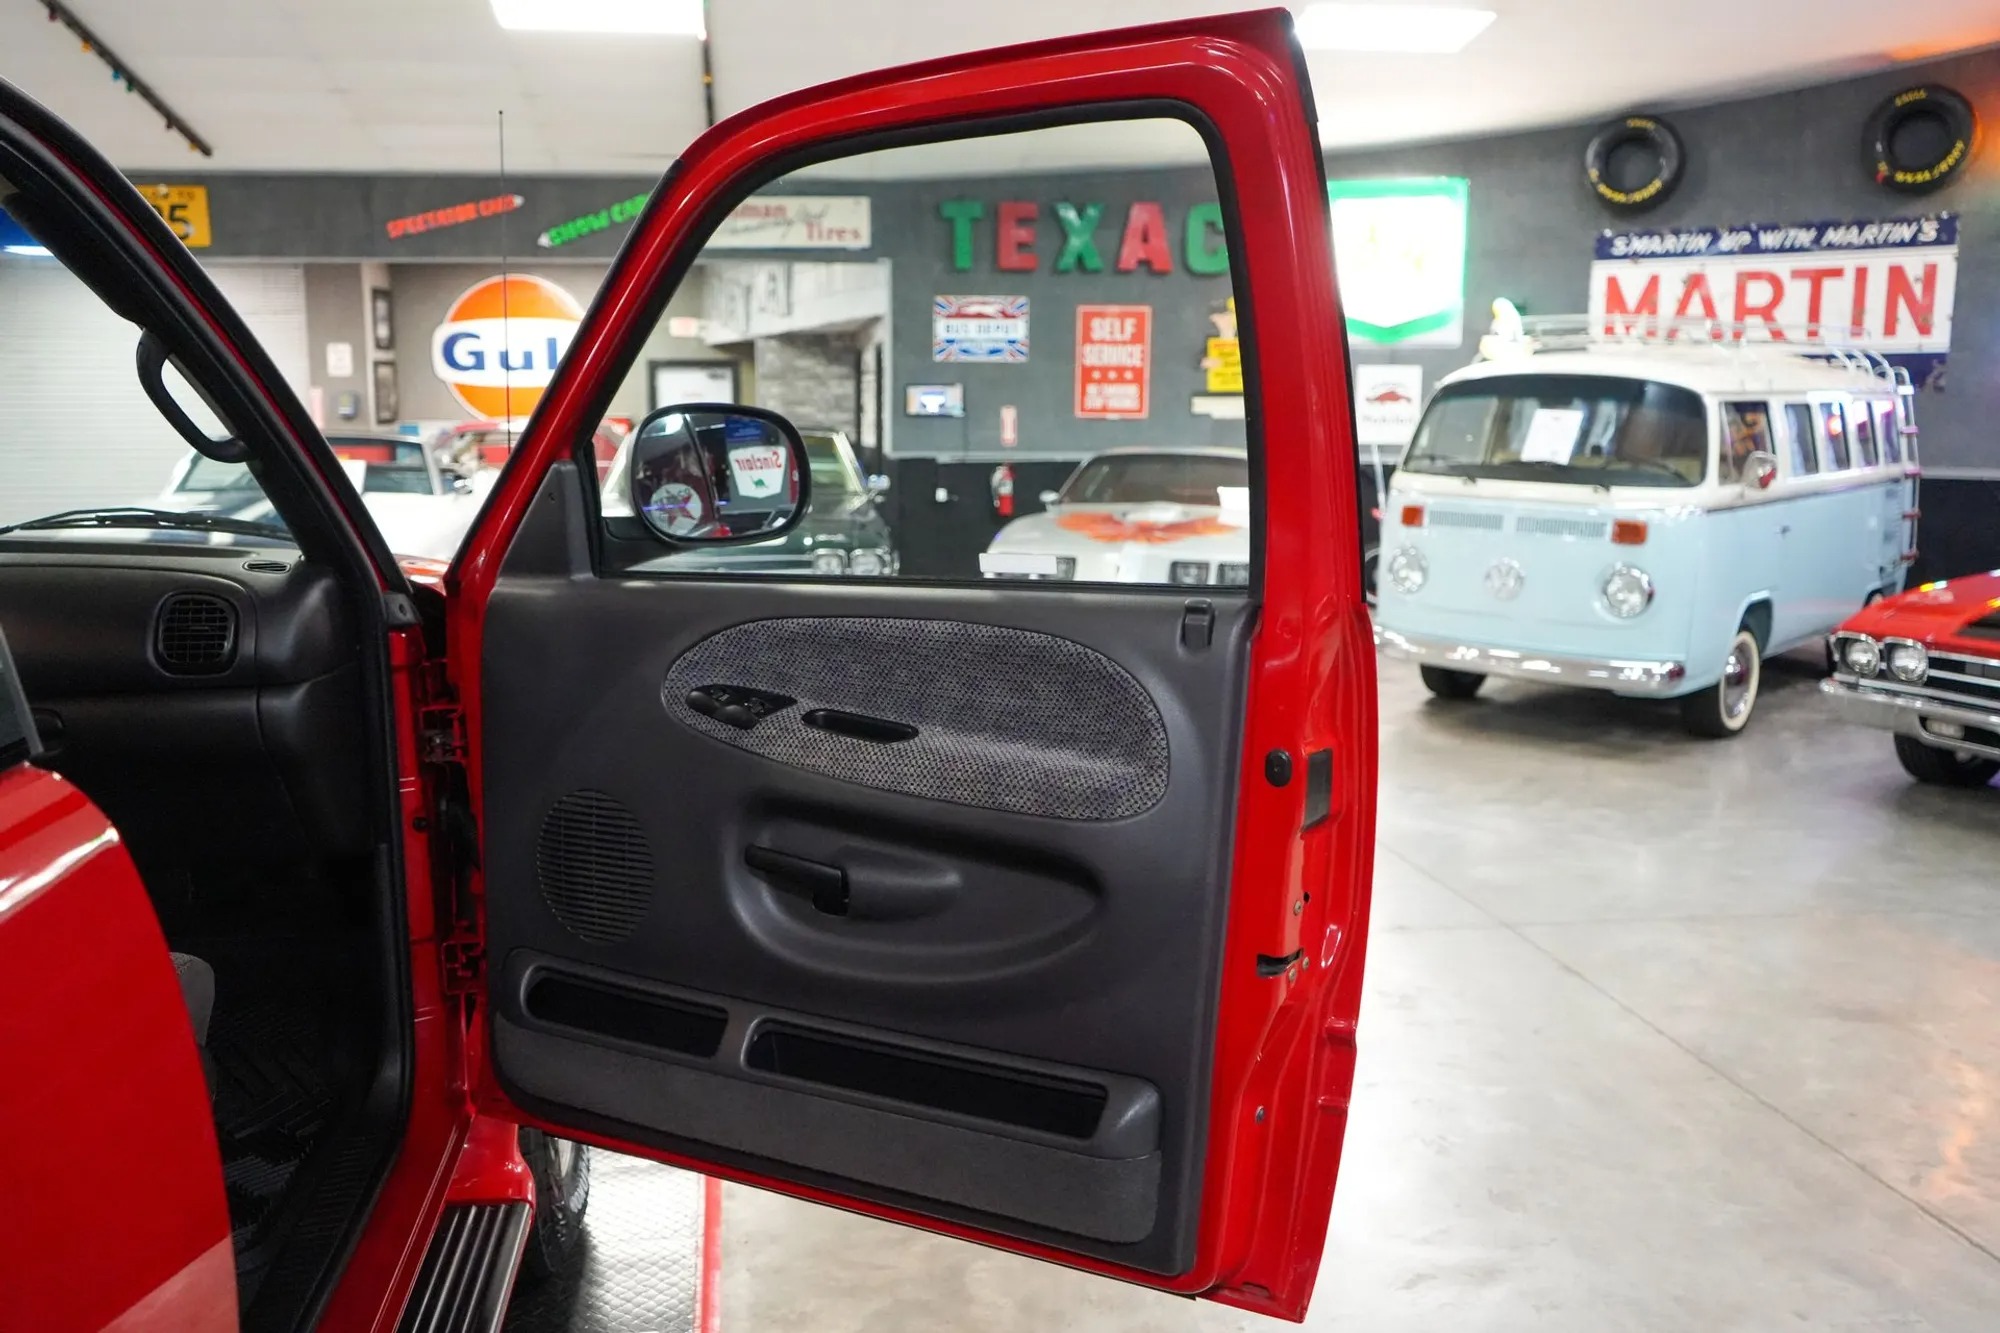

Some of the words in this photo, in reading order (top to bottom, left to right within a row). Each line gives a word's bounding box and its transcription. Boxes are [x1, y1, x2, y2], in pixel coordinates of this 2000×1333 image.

[548, 207, 611, 246] SHOW
[610, 192, 653, 223] CAR
[940, 200, 1229, 273] TEXAC
[1758, 225, 1818, 250] WITH
[1820, 217, 1939, 247] MARTIN'S
[1603, 262, 1938, 341] MARTIN
[1090, 317, 1137, 340] SELF
[442, 331, 559, 371] Gul
[1082, 343, 1143, 367] SERVICE
